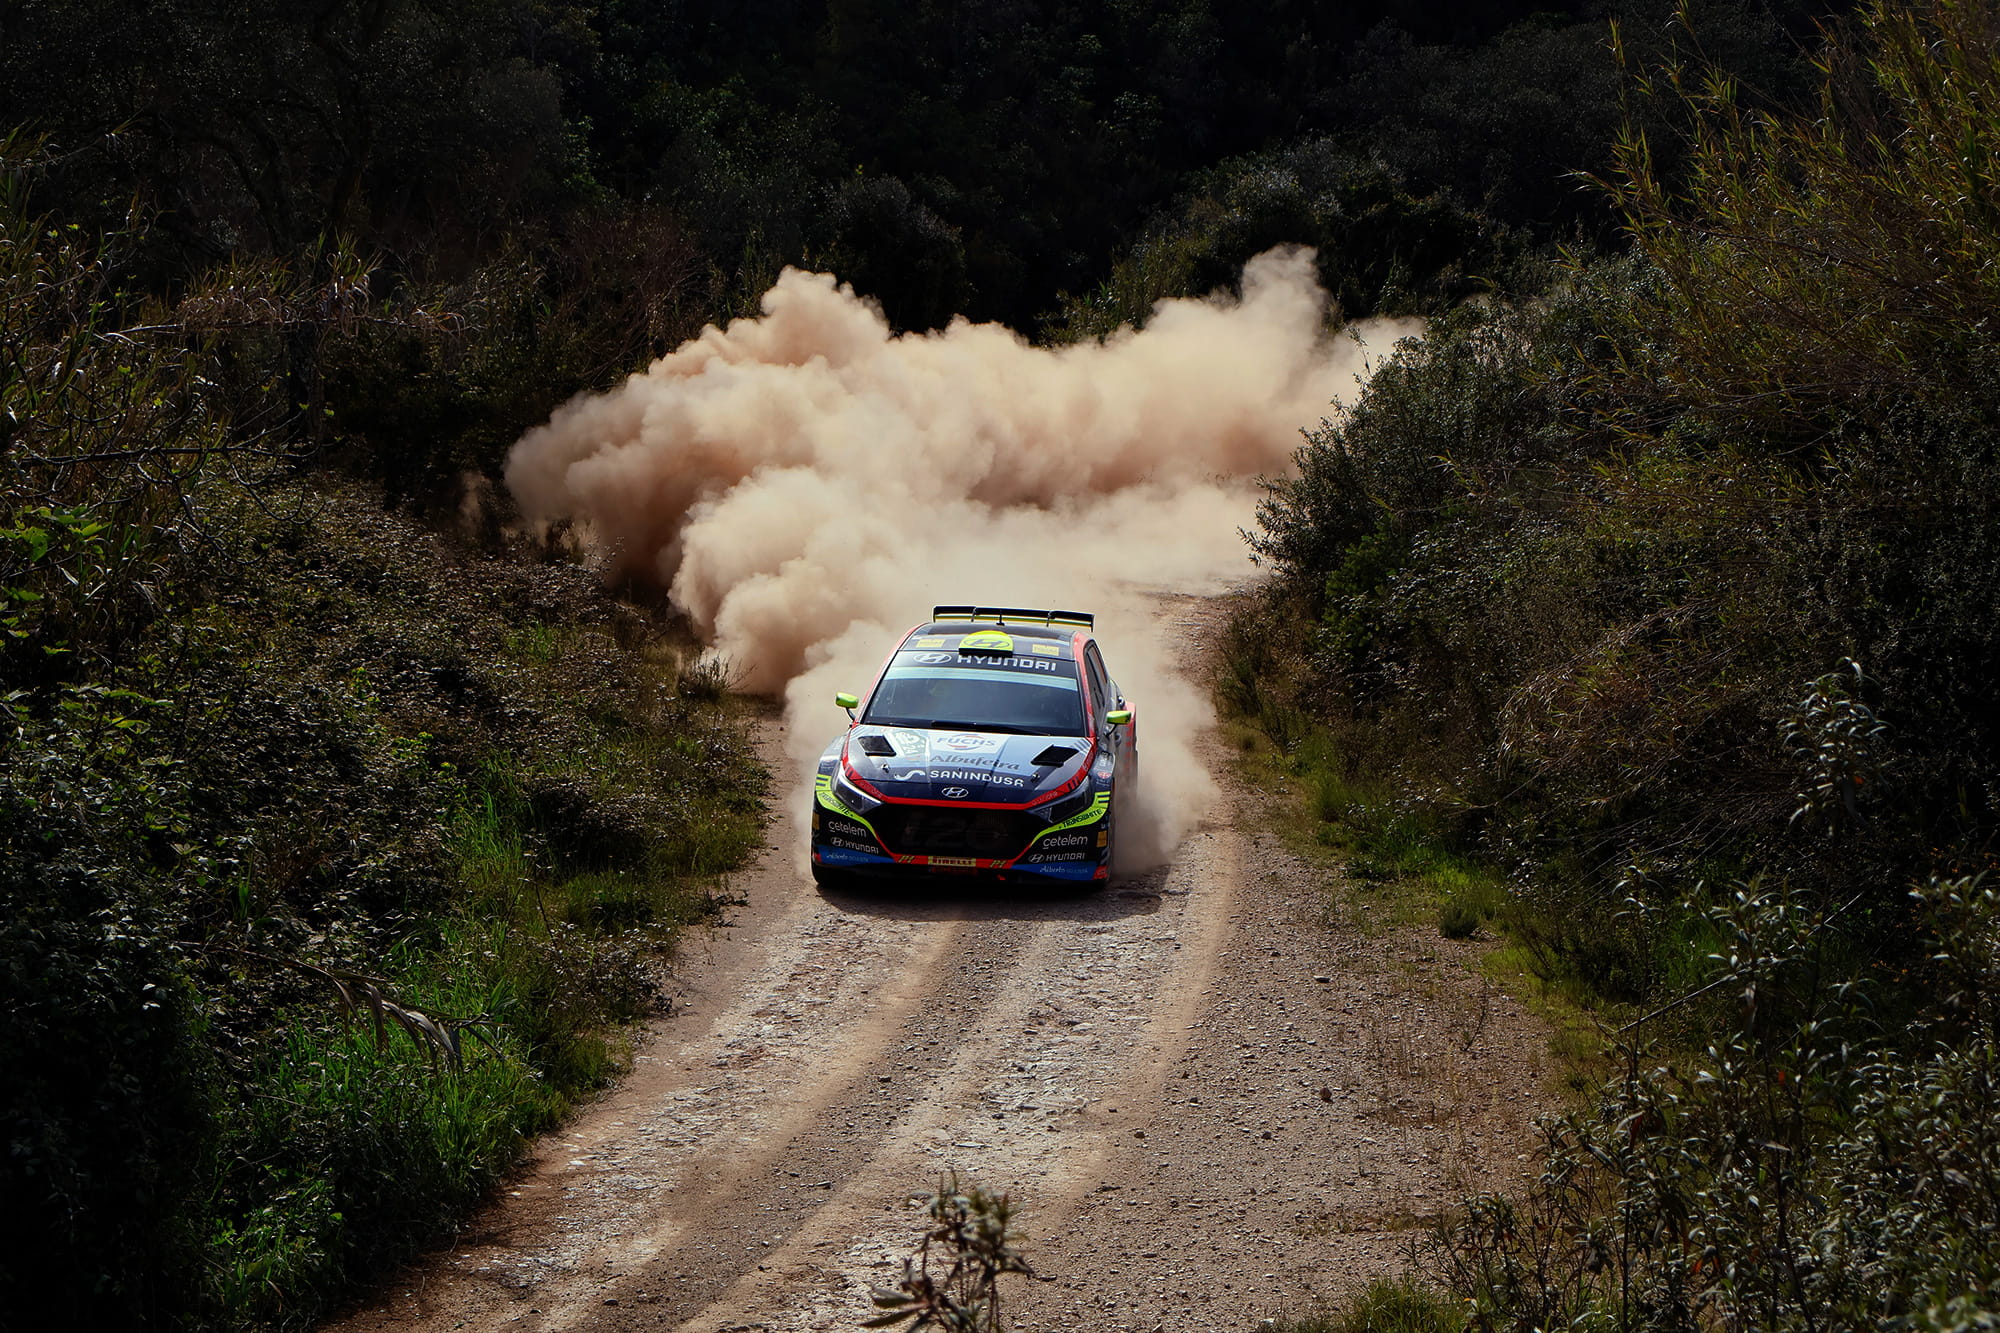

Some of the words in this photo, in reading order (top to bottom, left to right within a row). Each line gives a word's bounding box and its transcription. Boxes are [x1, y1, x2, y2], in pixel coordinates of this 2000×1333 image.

[957, 655, 1056, 671] HYUNDAI
[936, 736, 998, 748] FUCHS
[929, 753, 1020, 770] Albufeira
[930, 770, 1025, 788] SANINDUSA
[828, 821, 867, 838] cetelem
[845, 840, 879, 854] HYUNDAI
[1042, 834, 1088, 849] cetelem
[932, 856, 972, 866] PIRELLI
[1046, 853, 1086, 862] HYUNDAI
